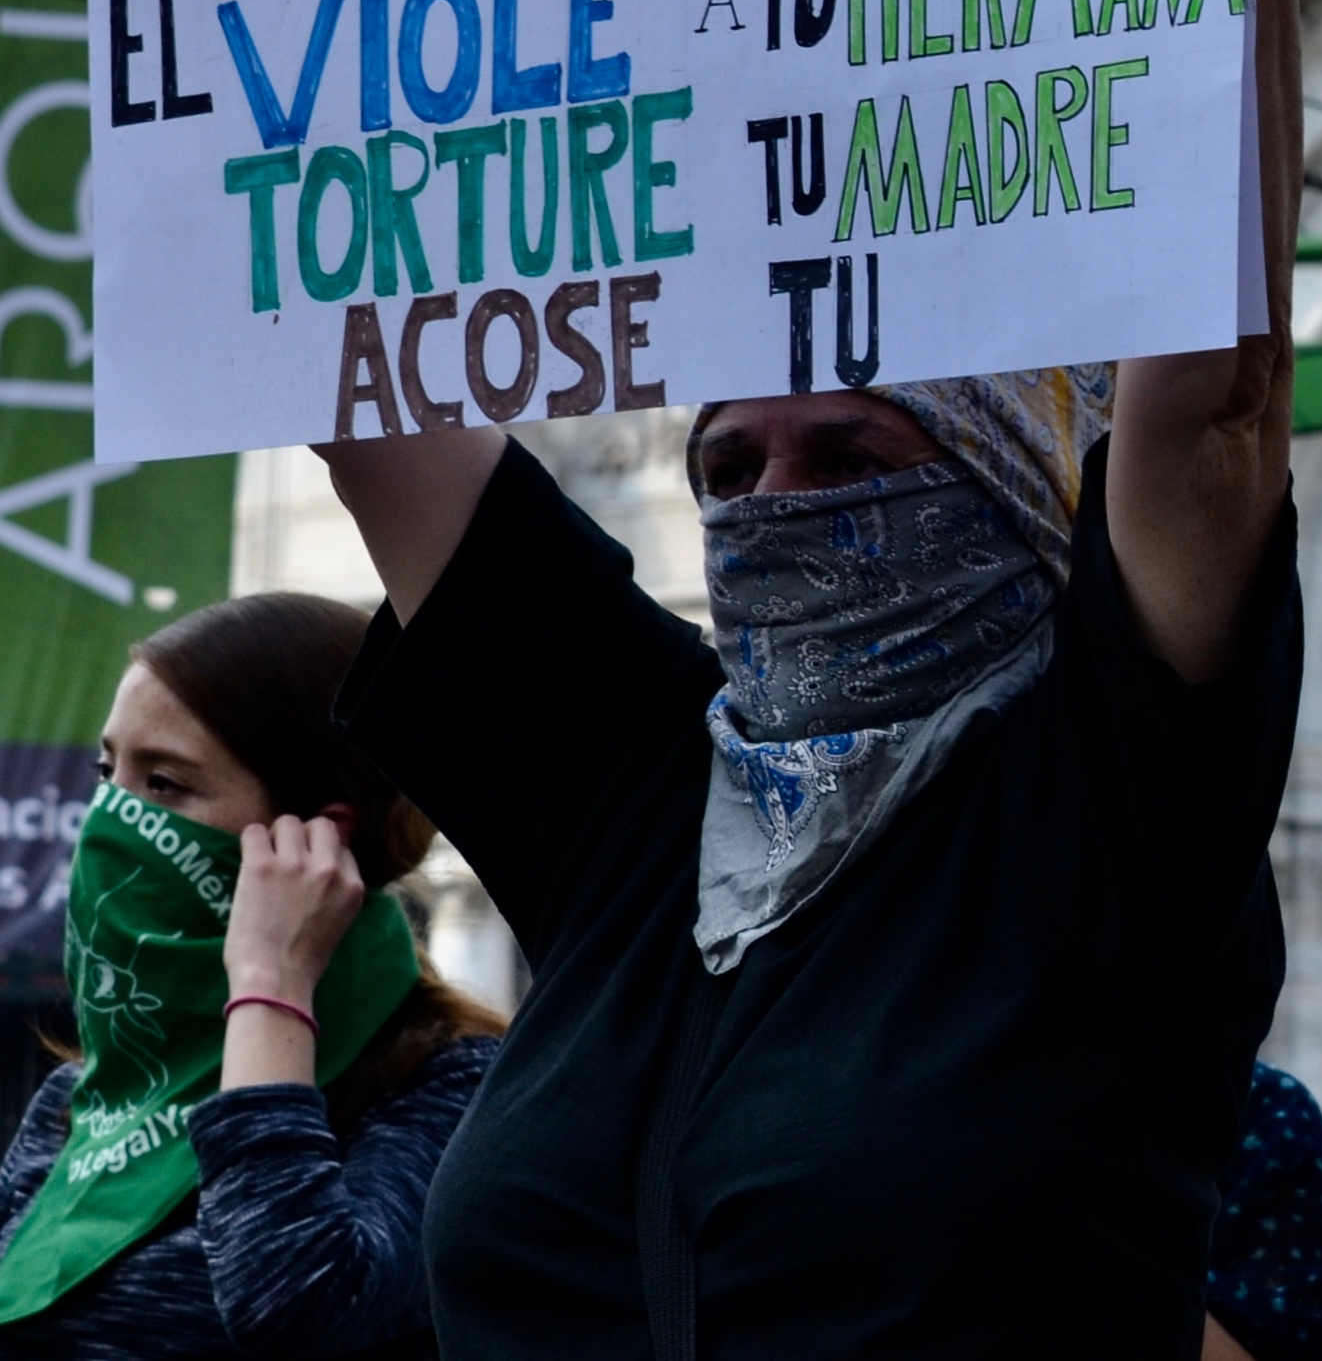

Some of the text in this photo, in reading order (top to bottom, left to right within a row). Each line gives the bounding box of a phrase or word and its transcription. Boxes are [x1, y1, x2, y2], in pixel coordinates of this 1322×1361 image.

[225, 56, 1151, 314] TORTURE TU MADRE
[332, 252, 880, 442] ACOSE TU
